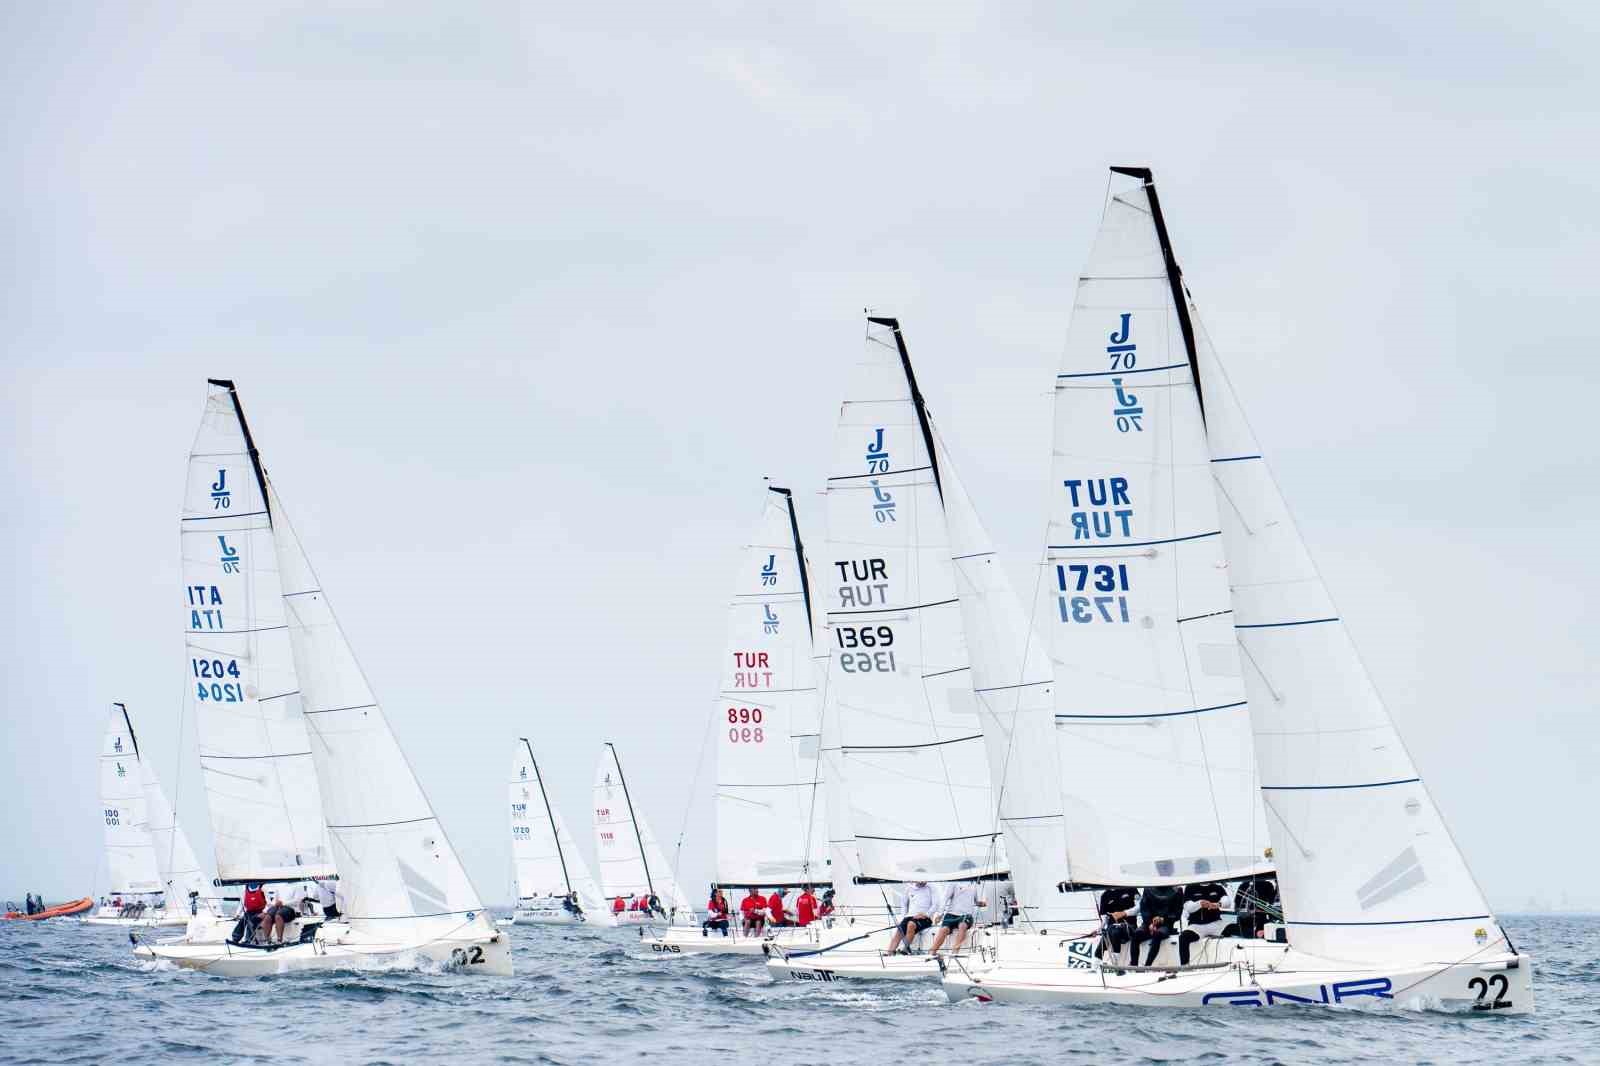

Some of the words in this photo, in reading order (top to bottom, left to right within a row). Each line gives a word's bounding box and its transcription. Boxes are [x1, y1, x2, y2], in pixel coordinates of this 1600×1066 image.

[1110, 313, 1131, 344] J
[1110, 352, 1136, 370] 70
[868, 428, 884, 453] J
[868, 459, 889, 473] 70
[212, 469, 226, 491] J
[213, 496, 230, 509] 70
[1063, 477, 1131, 507] TUR
[762, 555, 775, 572] J
[835, 558, 888, 582] TUR
[762, 576, 777, 586] 70
[1056, 564, 1129, 592] 1731
[187, 585, 223, 606] ITA
[836, 626, 894, 648] 1369
[192, 658, 241, 679] 1204
[733, 652, 769, 668] TUR
[728, 708, 762, 724] 890
[652, 944, 681, 953] GAS
[1468, 974, 1512, 1010] 22
